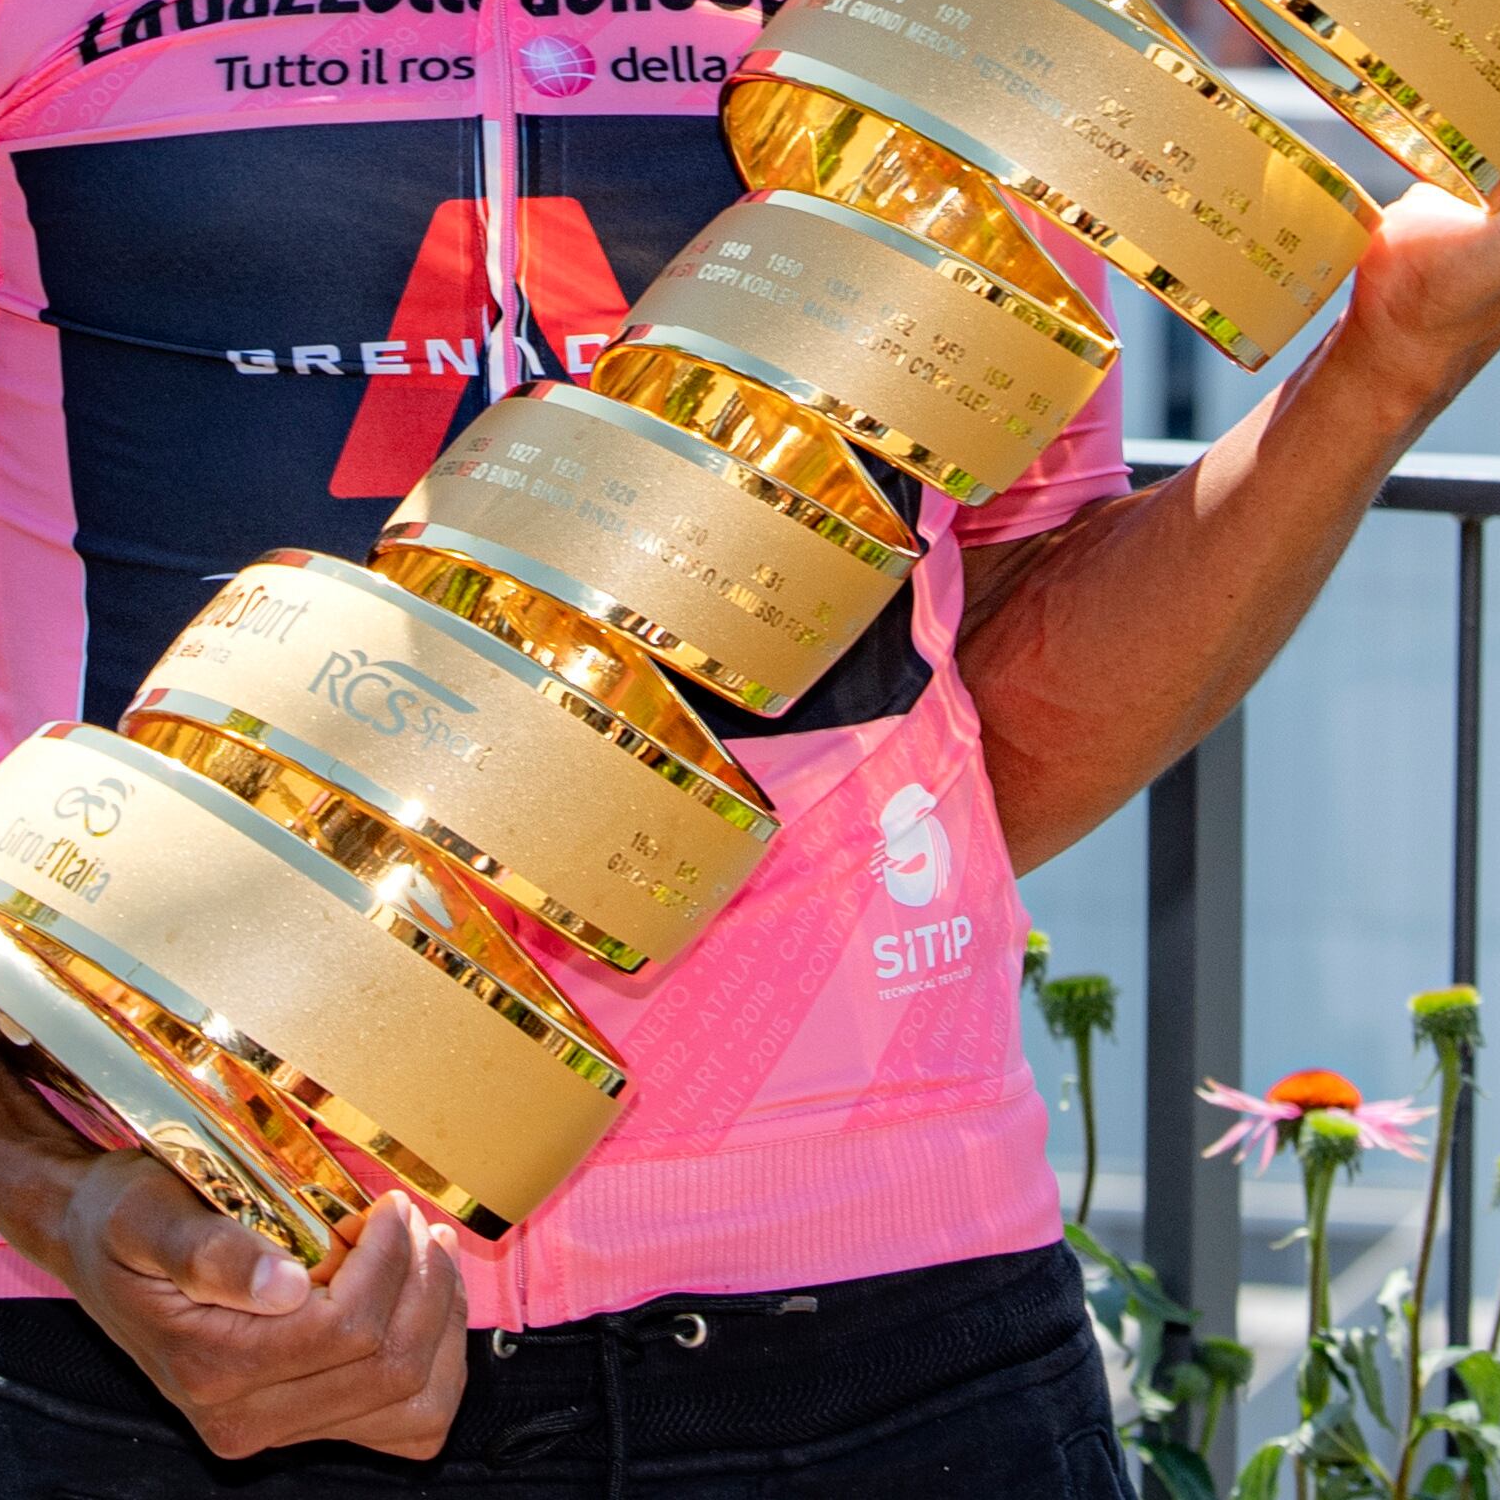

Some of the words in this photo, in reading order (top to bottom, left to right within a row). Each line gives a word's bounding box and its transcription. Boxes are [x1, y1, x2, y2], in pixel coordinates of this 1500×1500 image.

[932, 0, 974, 33] 1970
[214, 53, 349, 93] Tutto
[359, 49, 388, 86] il
[717, 236, 753, 265] 1949
[696, 258, 742, 291] COPPI
[505, 438, 543, 468] 1927
[484, 462, 530, 493] BINDA
[308, 650, 418, 736] RCS
[745, 1010, 797, 1074] 2015
[792, 857, 885, 998] CONTADO
[877, 975, 936, 1002] TECHNICAL
[640, 1034, 694, 1093] 1912
[693, 944, 759, 1029] ATALA
[663, 1048, 730, 1122] HART
[729, 975, 779, 1041] 2019
